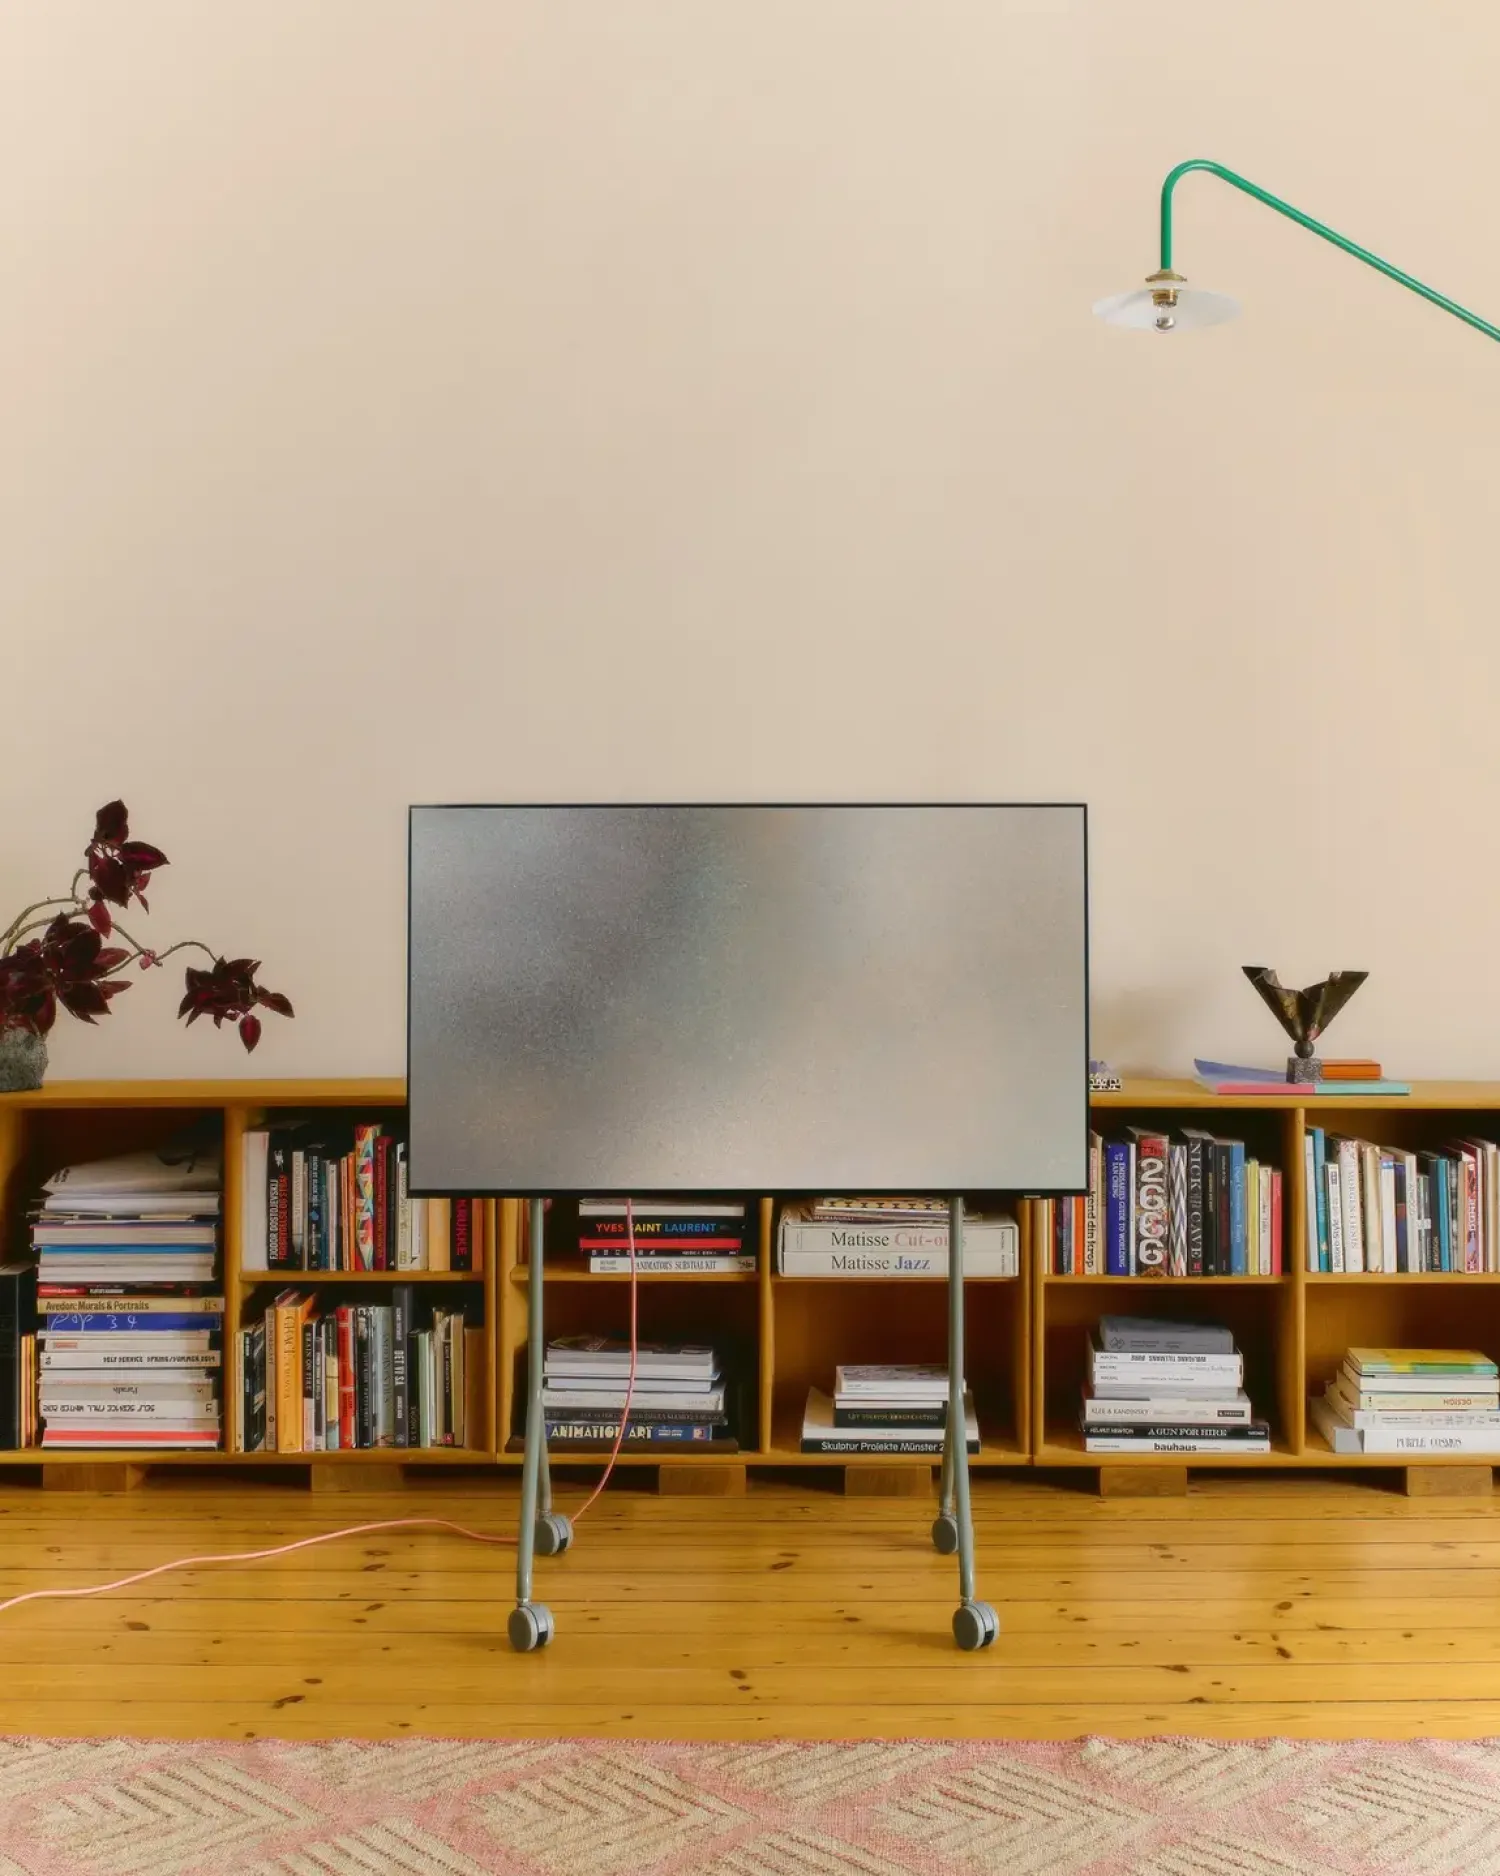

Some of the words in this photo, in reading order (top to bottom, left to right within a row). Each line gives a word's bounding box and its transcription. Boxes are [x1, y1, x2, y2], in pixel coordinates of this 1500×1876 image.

[1190, 1143, 1202, 1190] NICK
[1118, 1202, 1126, 1221] GUIDE
[1139, 1157, 1165, 1264] 2666
[595, 1223, 624, 1232] YVES
[664, 1223, 716, 1232] LAURENT
[1088, 1221, 1096, 1238] din
[1118, 1223, 1126, 1232] TO
[831, 1231, 889, 1247] Matisse
[894, 1231, 967, 1247] Cut-os
[1190, 1212, 1202, 1258] CAVE
[1085, 1240, 1096, 1268] krop
[831, 1255, 889, 1270] Matisse
[894, 1255, 931, 1270] Jazz
[46, 1301, 77, 1311] Avedon:
[78, 1301, 106, 1311] Murals
[107, 1302, 112, 1311] &
[114, 1301, 149, 1311] Portraits
[394, 1350, 404, 1363] DET
[305, 1358, 312, 1370] ON
[1443, 1398, 1472, 1406] DESIGN
[628, 1425, 653, 1439] ART
[1179, 1429, 1199, 1437] FOR
[1200, 1429, 1227, 1437] HIRE
[821, 1441, 859, 1451] Skulptur
[860, 1442, 899, 1452] Projekte
[900, 1441, 937, 1451] Münster
[1153, 1442, 1197, 1452] bauhaus
